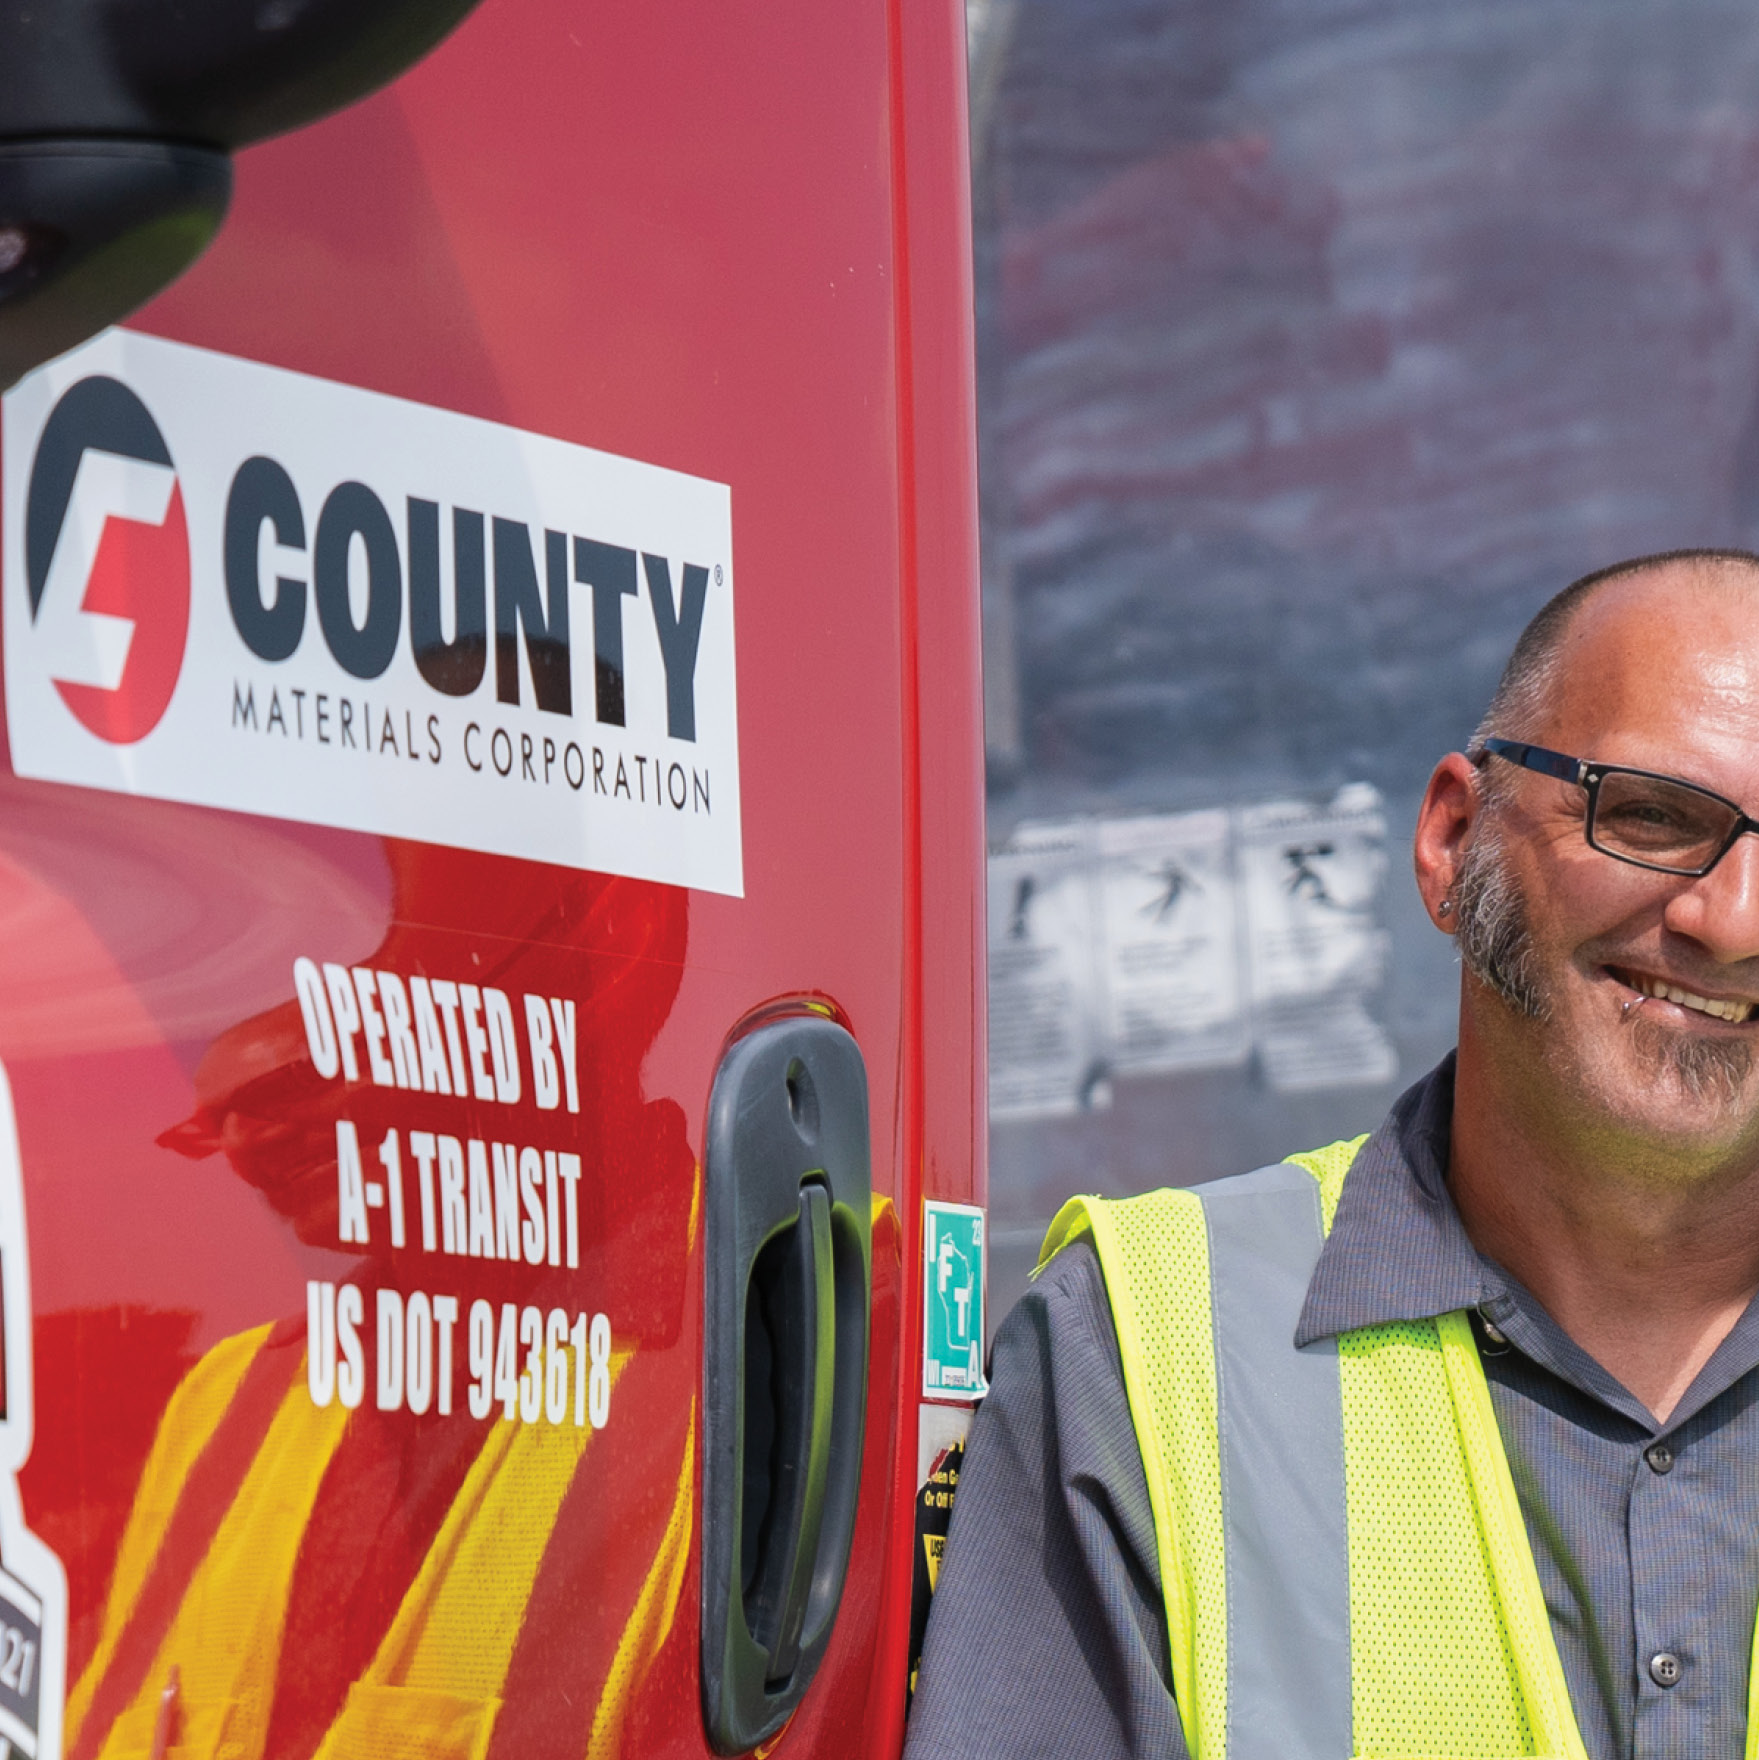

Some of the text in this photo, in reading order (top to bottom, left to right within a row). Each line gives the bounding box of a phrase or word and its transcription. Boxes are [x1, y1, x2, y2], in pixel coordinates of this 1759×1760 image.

[231, 678, 712, 817] MATERIALS CORPORATION
[293, 955, 580, 1115] OPERATED BY
[335, 1120, 582, 1270] A-1 TRANSIT
[306, 1280, 612, 1430] US DOT 943618
